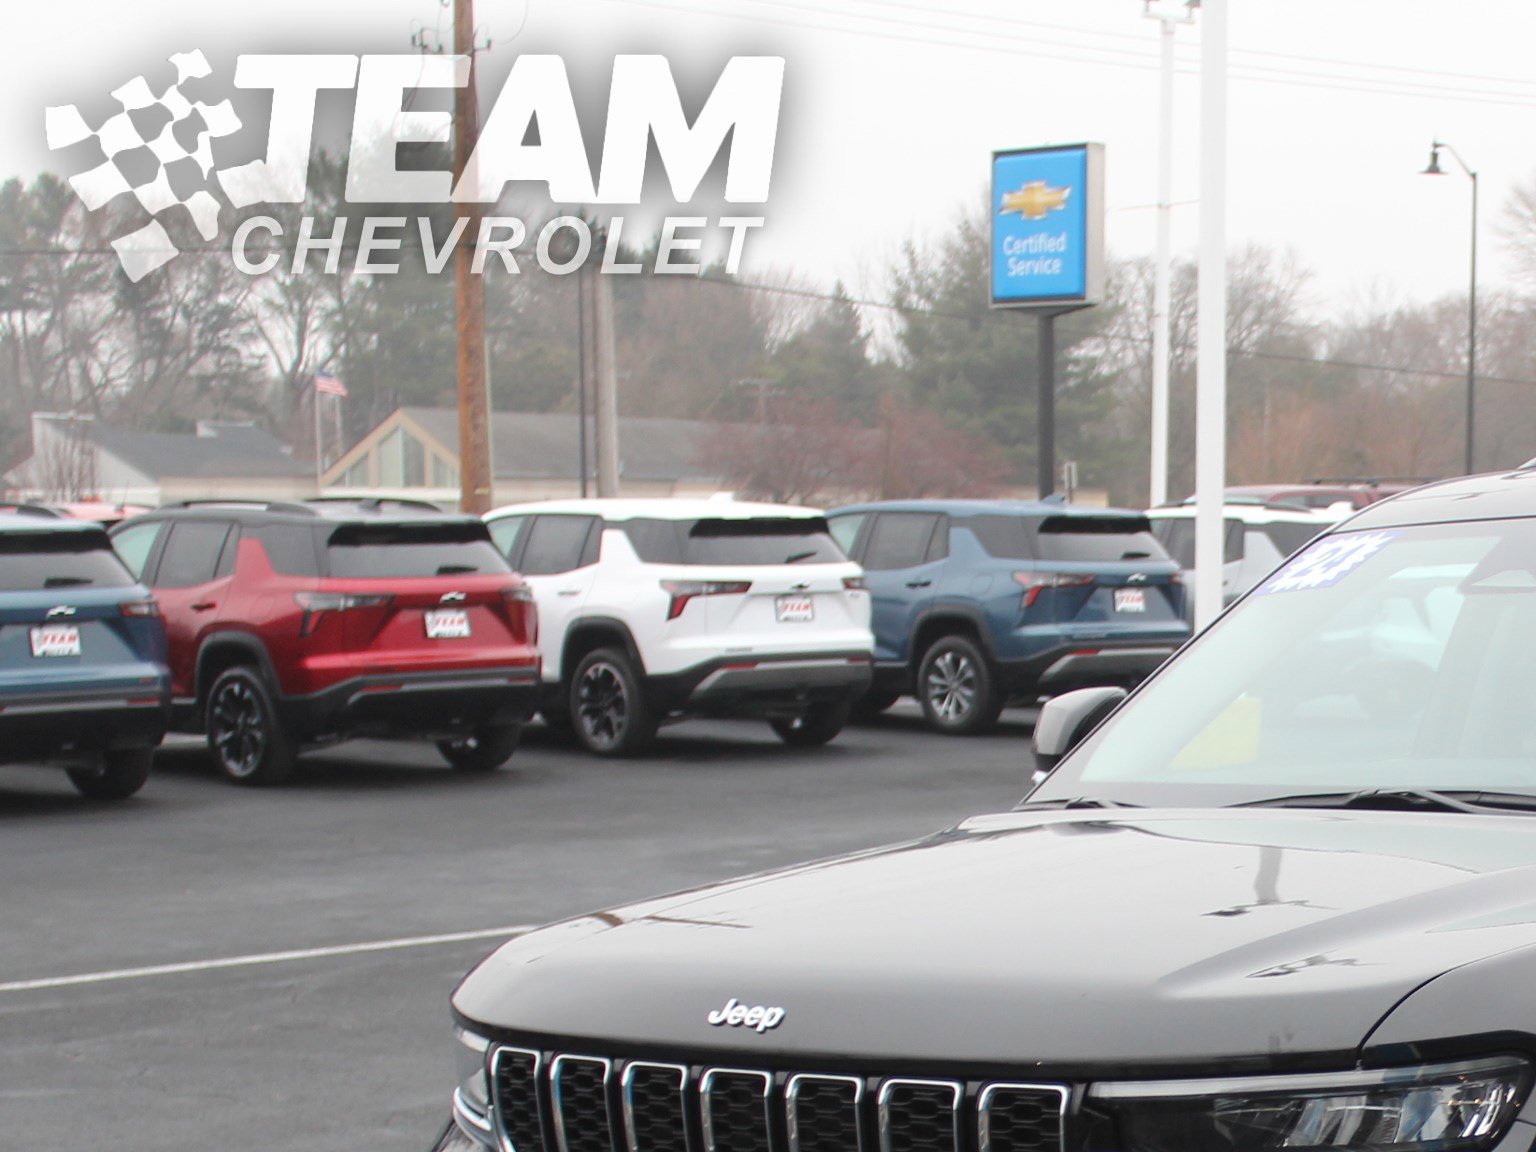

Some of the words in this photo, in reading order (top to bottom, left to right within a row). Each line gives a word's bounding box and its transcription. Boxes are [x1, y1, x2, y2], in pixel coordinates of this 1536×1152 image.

[1003, 232, 1067, 255] Certified
[1007, 256, 1062, 276] Service
[708, 998, 786, 1034] Jeep
